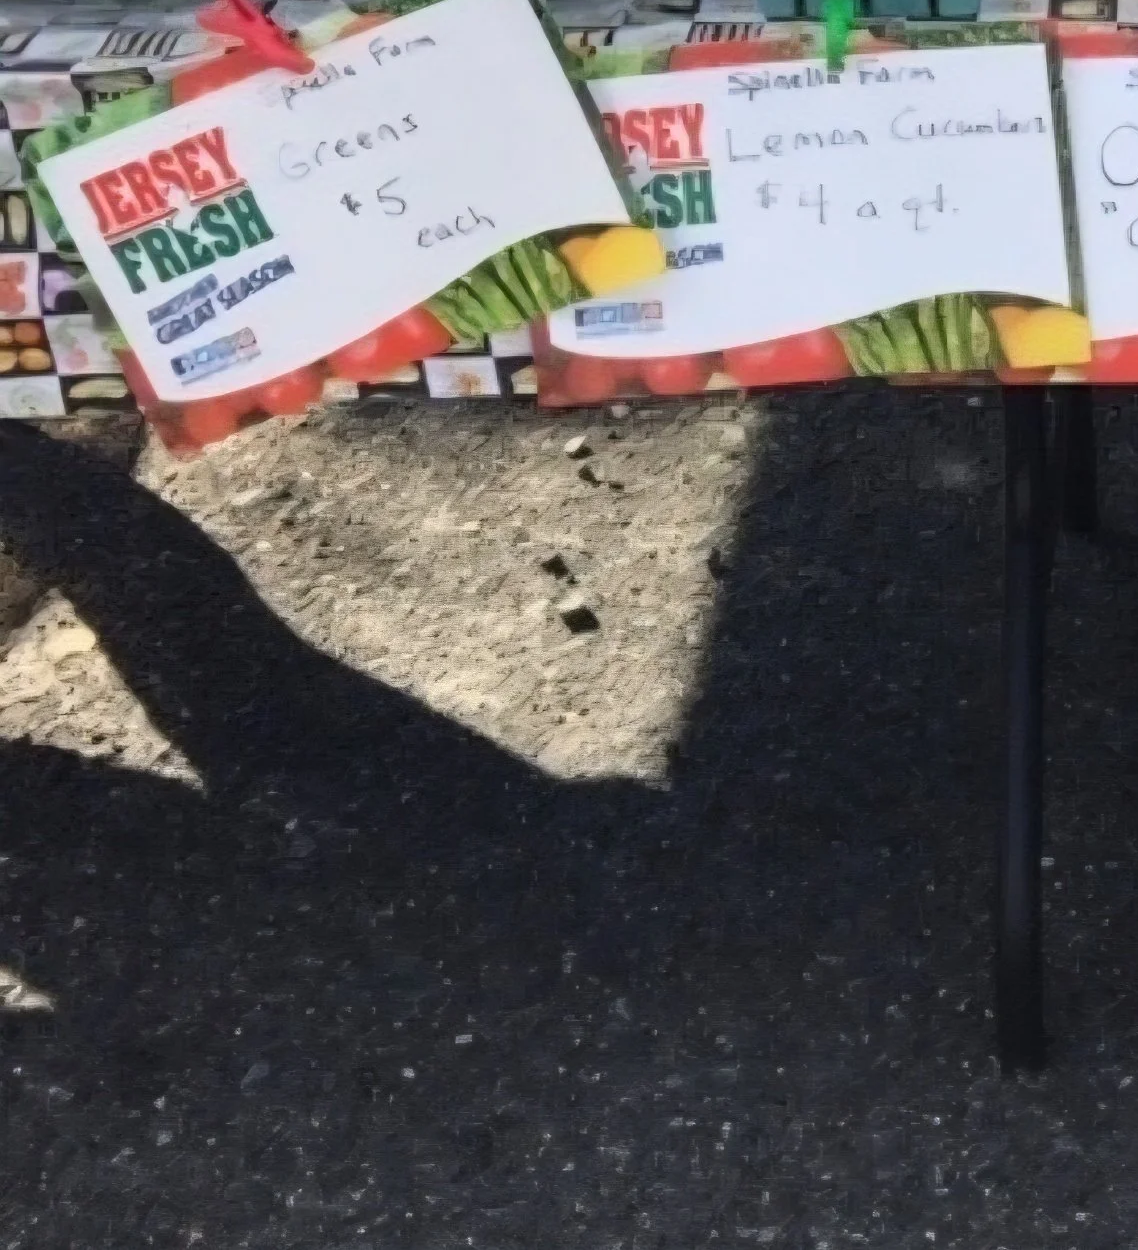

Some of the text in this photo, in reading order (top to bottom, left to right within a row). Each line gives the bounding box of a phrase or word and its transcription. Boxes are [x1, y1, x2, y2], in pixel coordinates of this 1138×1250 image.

[857, 57, 935, 86] Farm
[278, 113, 418, 180] Greens
[726, 128, 870, 162] Lemon
[80, 126, 237, 234] JERSEY
[107, 188, 275, 295] FRESH
[417, 206, 496, 248] each
